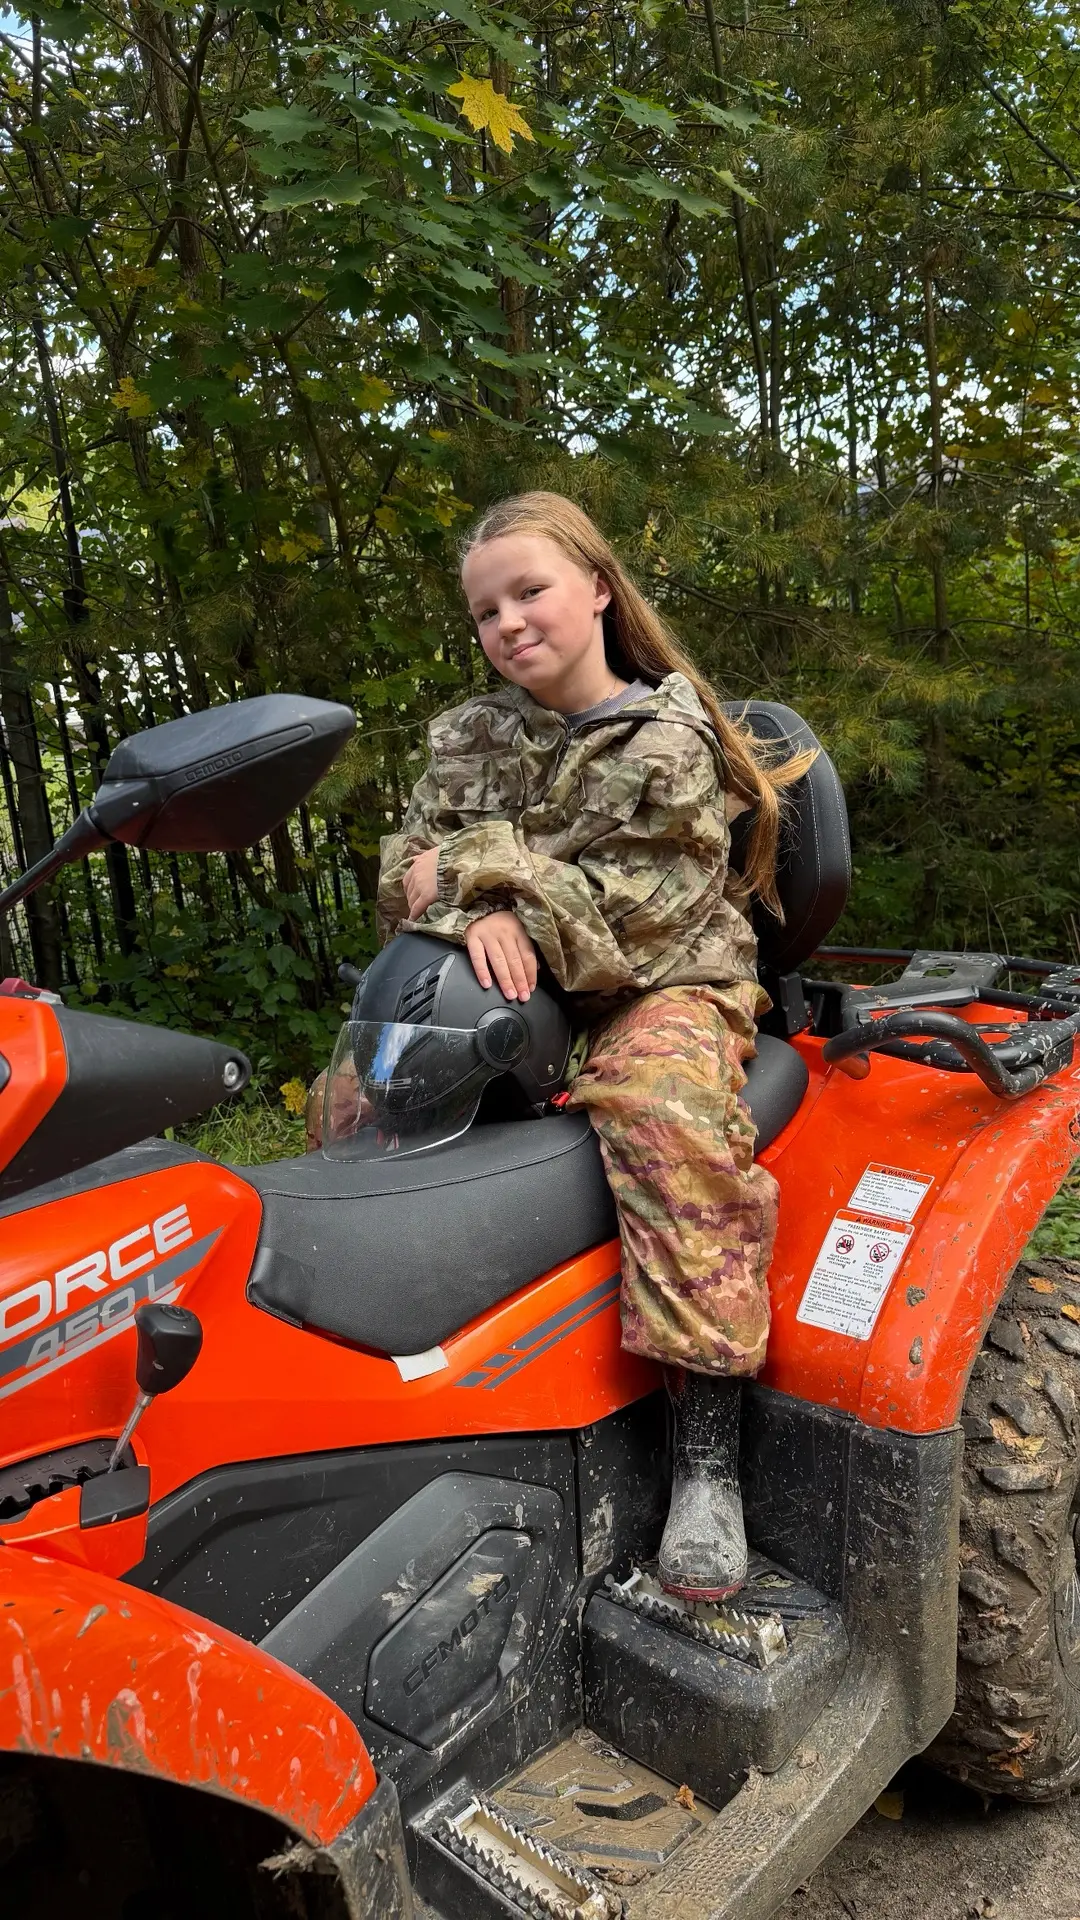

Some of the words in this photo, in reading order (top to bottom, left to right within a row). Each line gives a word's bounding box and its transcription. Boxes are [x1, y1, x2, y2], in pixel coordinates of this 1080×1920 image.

[185, 751, 242, 782] CFMOTO
[888, 1168, 918, 1181] WARNING
[863, 1218, 891, 1229] WARNING
[874, 1229, 891, 1237] SAFETY
[0, 1204, 193, 1343] ORCE
[26, 1287, 136, 1368] 450
[147, 1273, 176, 1301] L
[402, 1575, 511, 1697] CFMOTO
